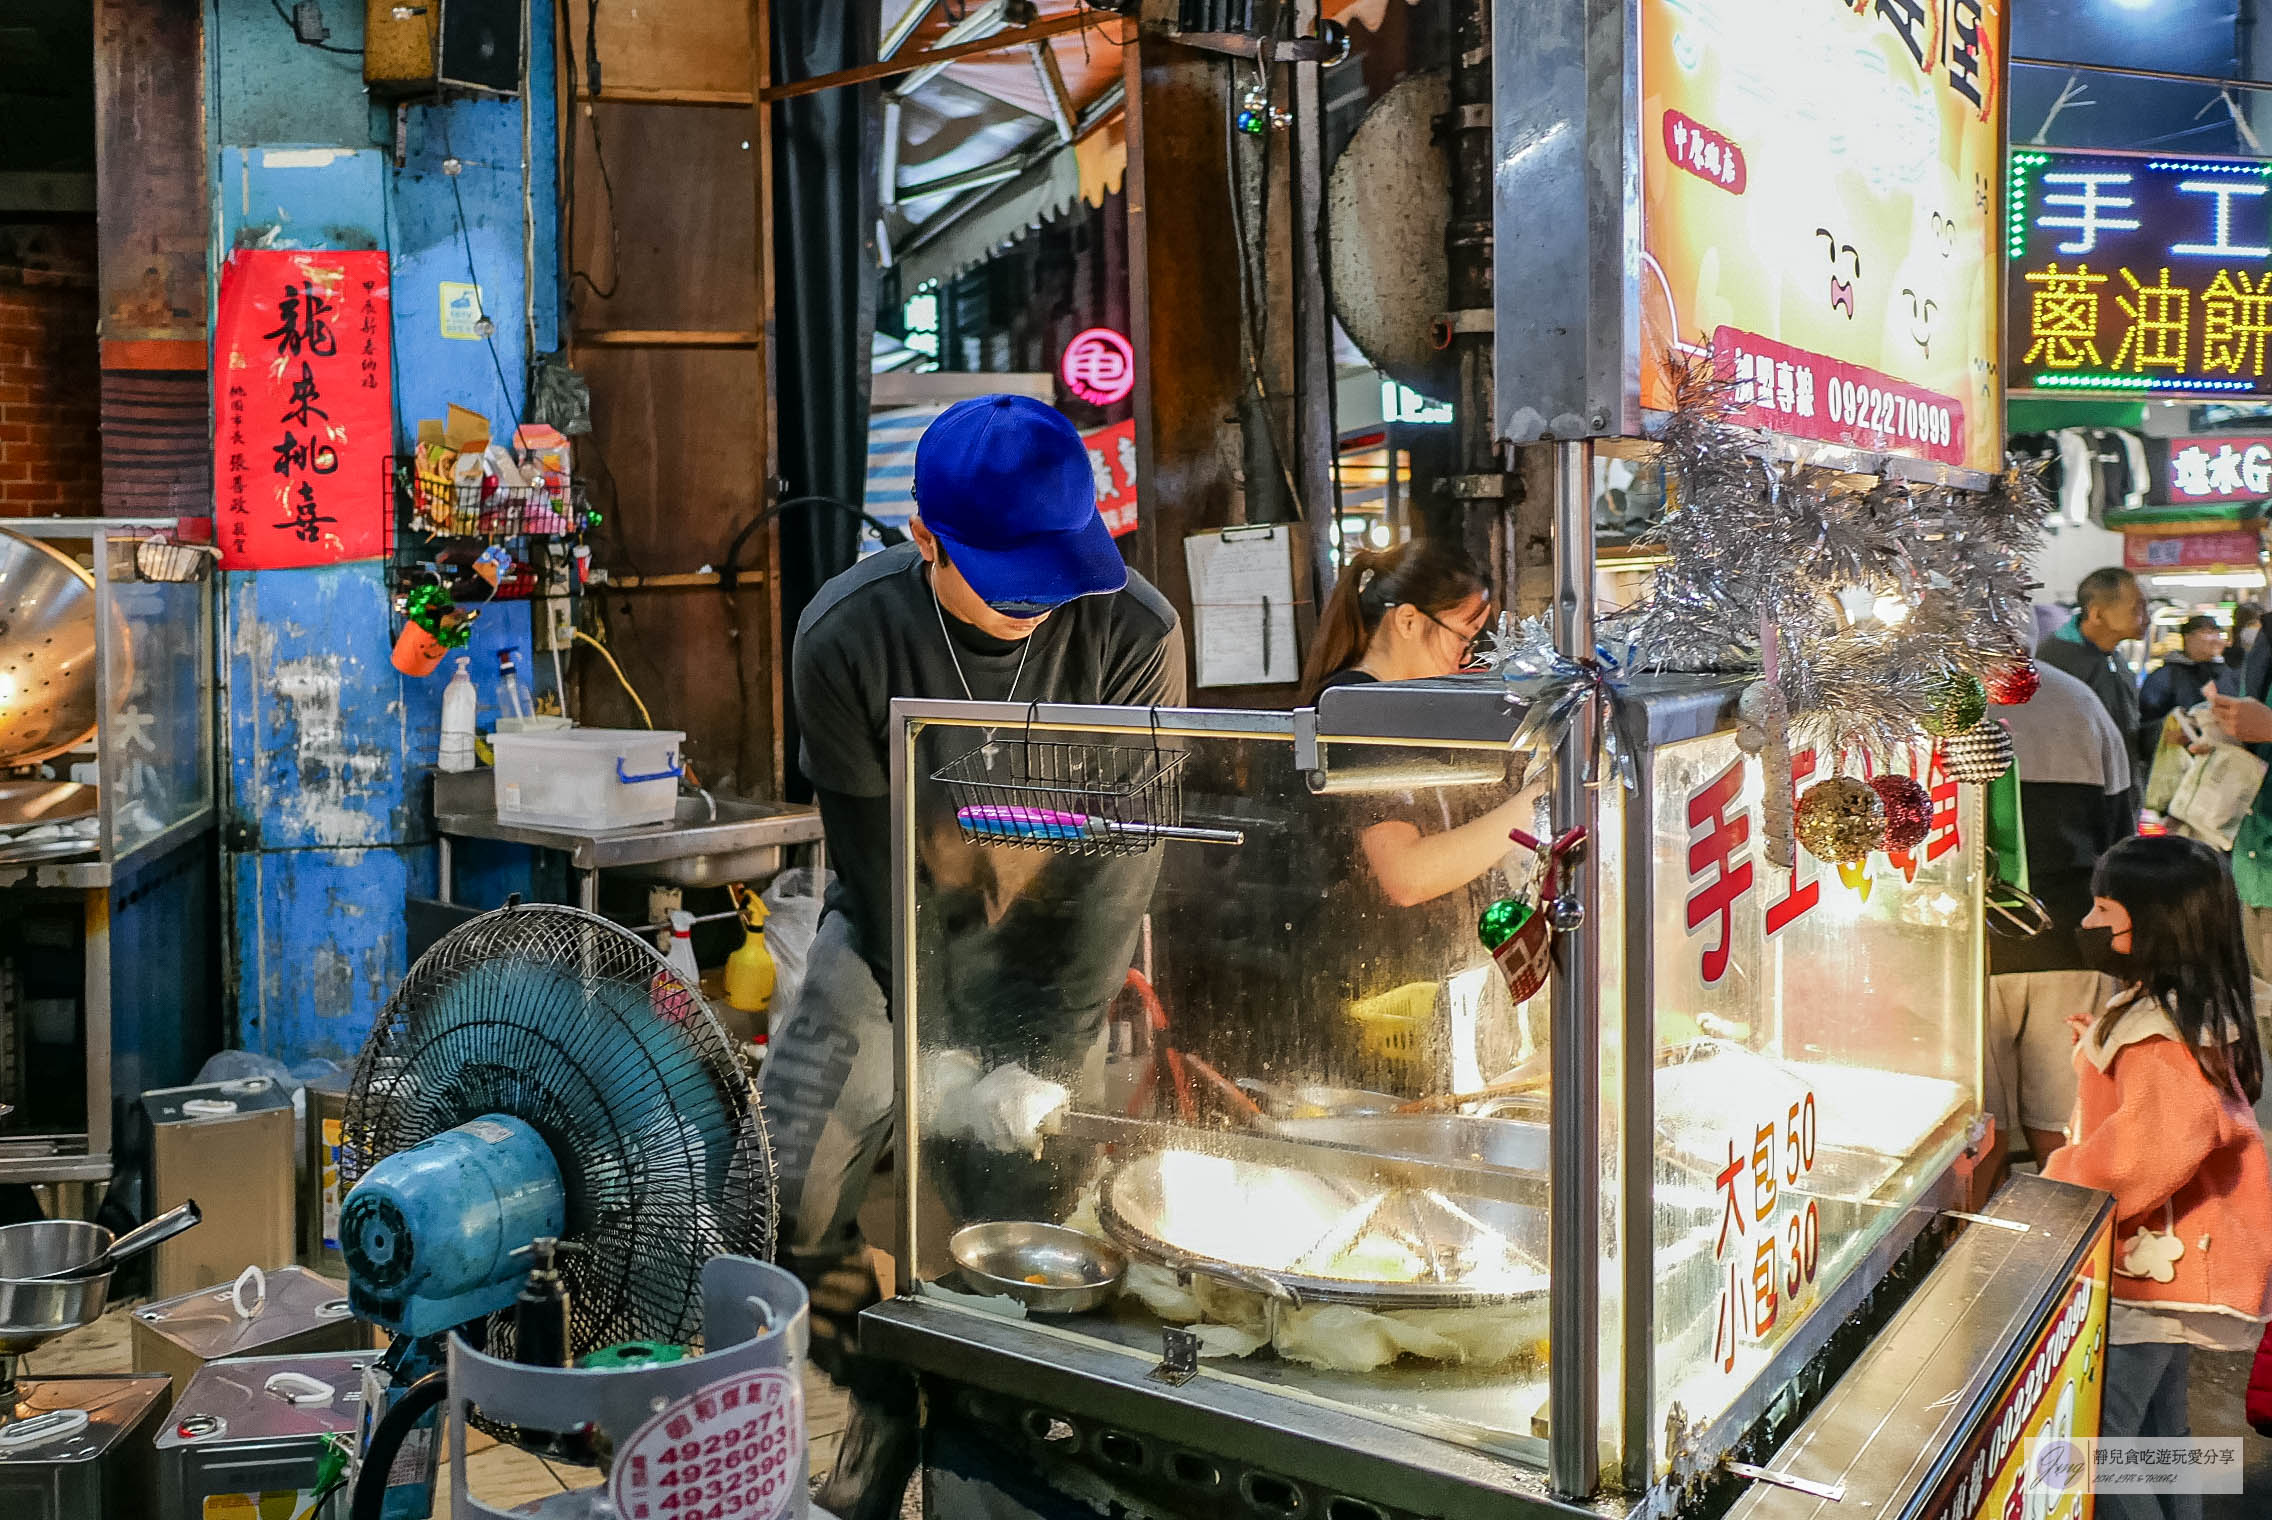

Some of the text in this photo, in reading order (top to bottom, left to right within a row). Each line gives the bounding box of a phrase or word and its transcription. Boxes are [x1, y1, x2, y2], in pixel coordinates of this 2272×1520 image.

[2035, 172, 2271, 257] 手工
[264, 281, 338, 543] 龍來桃喜
[1828, 377, 1950, 447] 0922270999
[1716, 1091, 1815, 1261] 大包 50
[1715, 1200, 1818, 1374] 小包 30
[1988, 1277, 2092, 1478] 0922270999
[657, 1404, 784, 1465] 4929271
[658, 1425, 787, 1488] 4926003
[658, 1446, 787, 1511] 4932390
[668, 1469, 786, 1520] 943001
